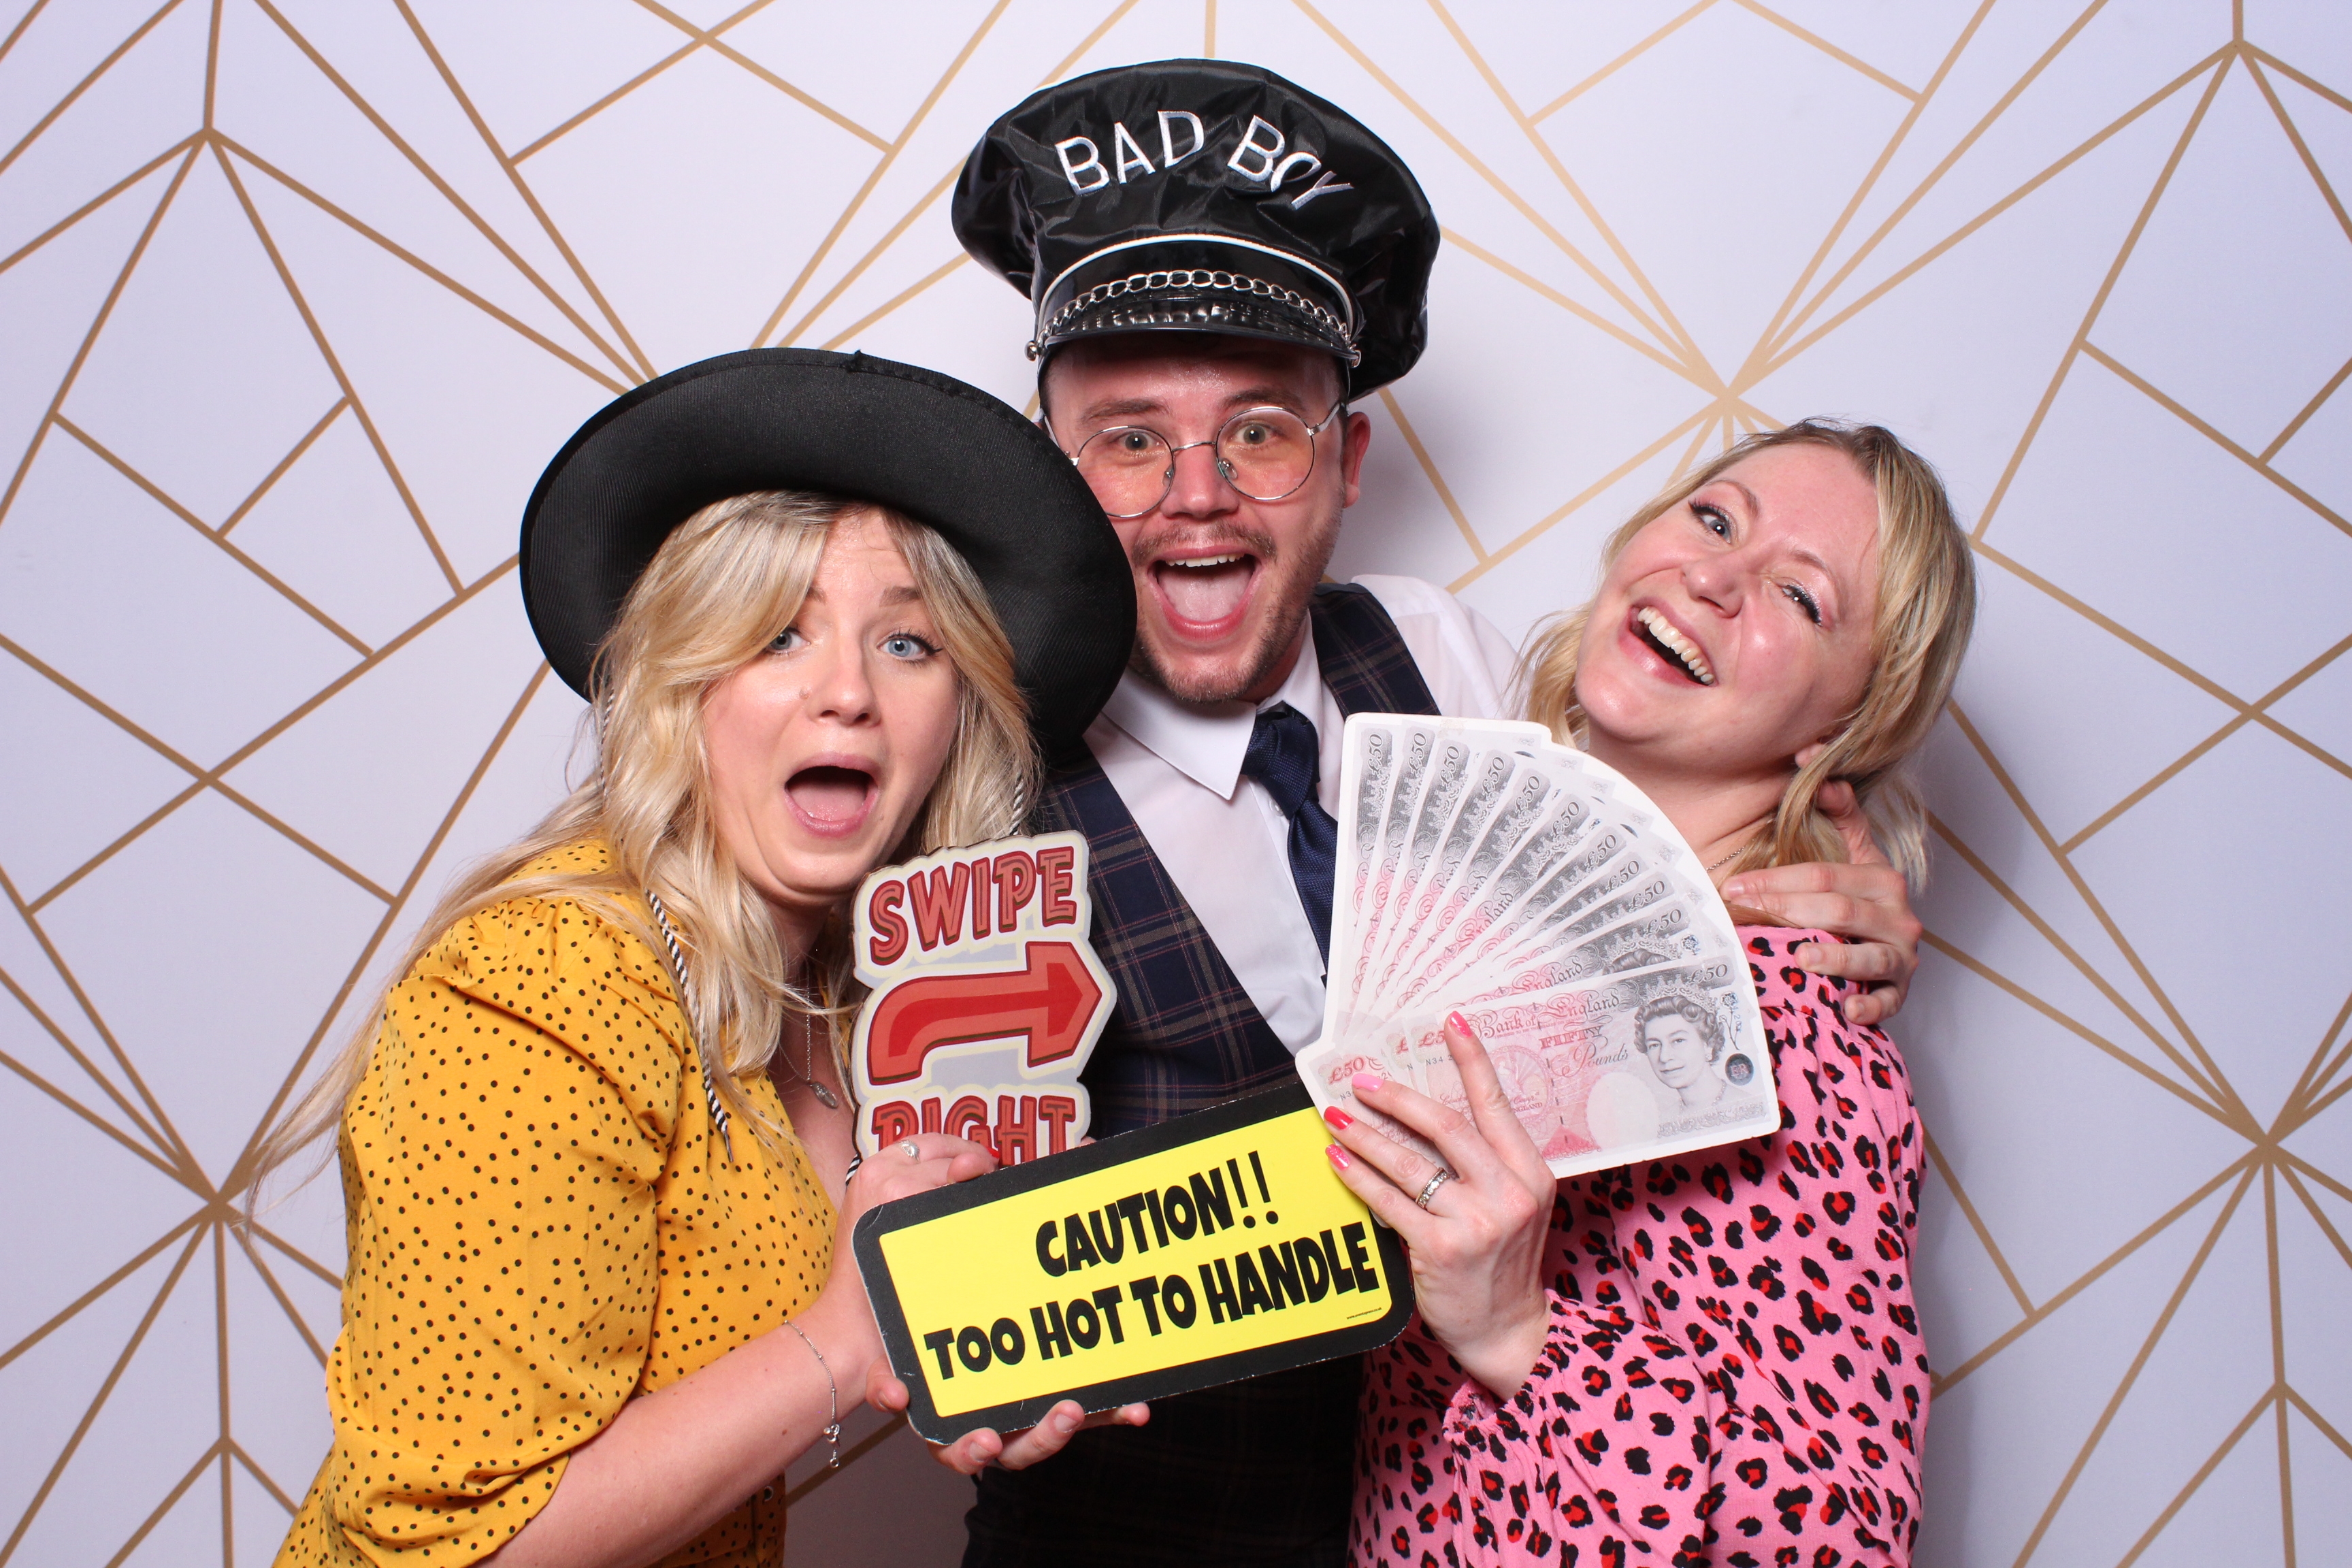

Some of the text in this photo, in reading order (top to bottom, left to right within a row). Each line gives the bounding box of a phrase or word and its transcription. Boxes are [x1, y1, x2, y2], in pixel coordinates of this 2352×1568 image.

[1055, 110, 1354, 210] BAD BOY
[1368, 733, 1383, 775] £50
[1408, 732, 1427, 775] £50
[1440, 745, 1460, 785] £50
[1481, 756, 1505, 797] £50
[1515, 775, 1541, 813] £50
[1550, 801, 1580, 838] £50
[1585, 834, 1617, 869] £50
[1605, 860, 1639, 892] £50
[869, 846, 1077, 966] SWIPE
[1629, 880, 1665, 912] £50
[1644, 909, 1682, 935] £50
[1687, 964, 1728, 984] £50
[1471, 991, 1620, 1040] Bank of England
[1418, 1030, 1446, 1047] £5
[1538, 1025, 1605, 1049] FIFTY
[1328, 1056, 1365, 1084] £50
[1550, 1036, 1629, 1077] Pounds
[1339, 1090, 1353, 1101] N3
[1512, 1102, 1543, 1113] NGLAND
[924, 1221, 1380, 1380] TOO HOT TO HANDLE
